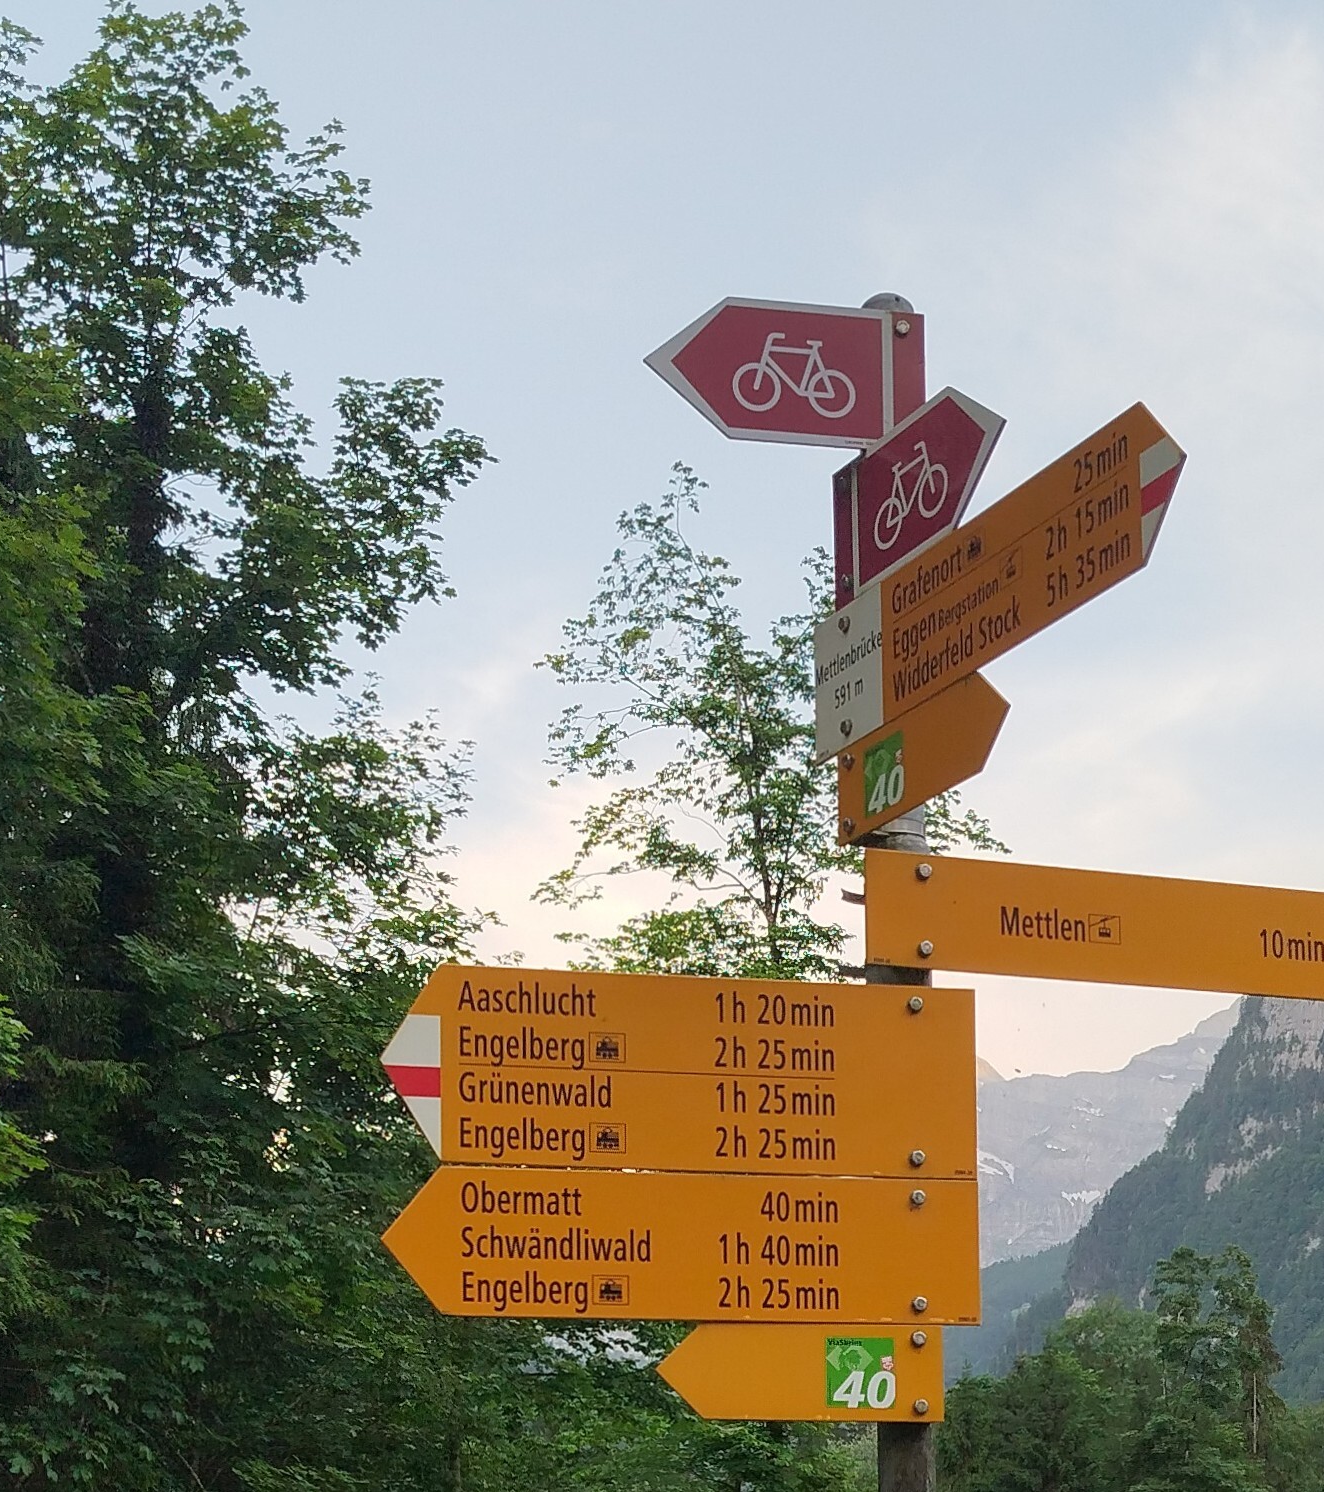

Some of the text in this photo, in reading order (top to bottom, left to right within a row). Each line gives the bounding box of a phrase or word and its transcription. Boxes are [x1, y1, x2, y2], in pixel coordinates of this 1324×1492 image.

[892, 544, 962, 614] Grafenort
[893, 610, 938, 662] Eggen
[938, 577, 999, 632] Bergstation
[816, 630, 883, 687] Mettlenbrücke
[893, 622, 975, 703] Widderfeld
[978, 595, 1022, 650] Stock
[834, 678, 864, 709] 591 m
[868, 765, 905, 814] 40
[1000, 905, 1086, 943] Mettlen
[458, 980, 596, 1018] Aaschlucht
[459, 1025, 585, 1066] Engelberg
[459, 1070, 612, 1109] Grünenwald
[459, 1116, 585, 1160] Engelberg
[461, 1180, 582, 1216] Obermatt
[461, 1224, 651, 1263] Schwändliwald
[462, 1270, 589, 1313] Engelberg
[833, 1370, 896, 1408] 40
